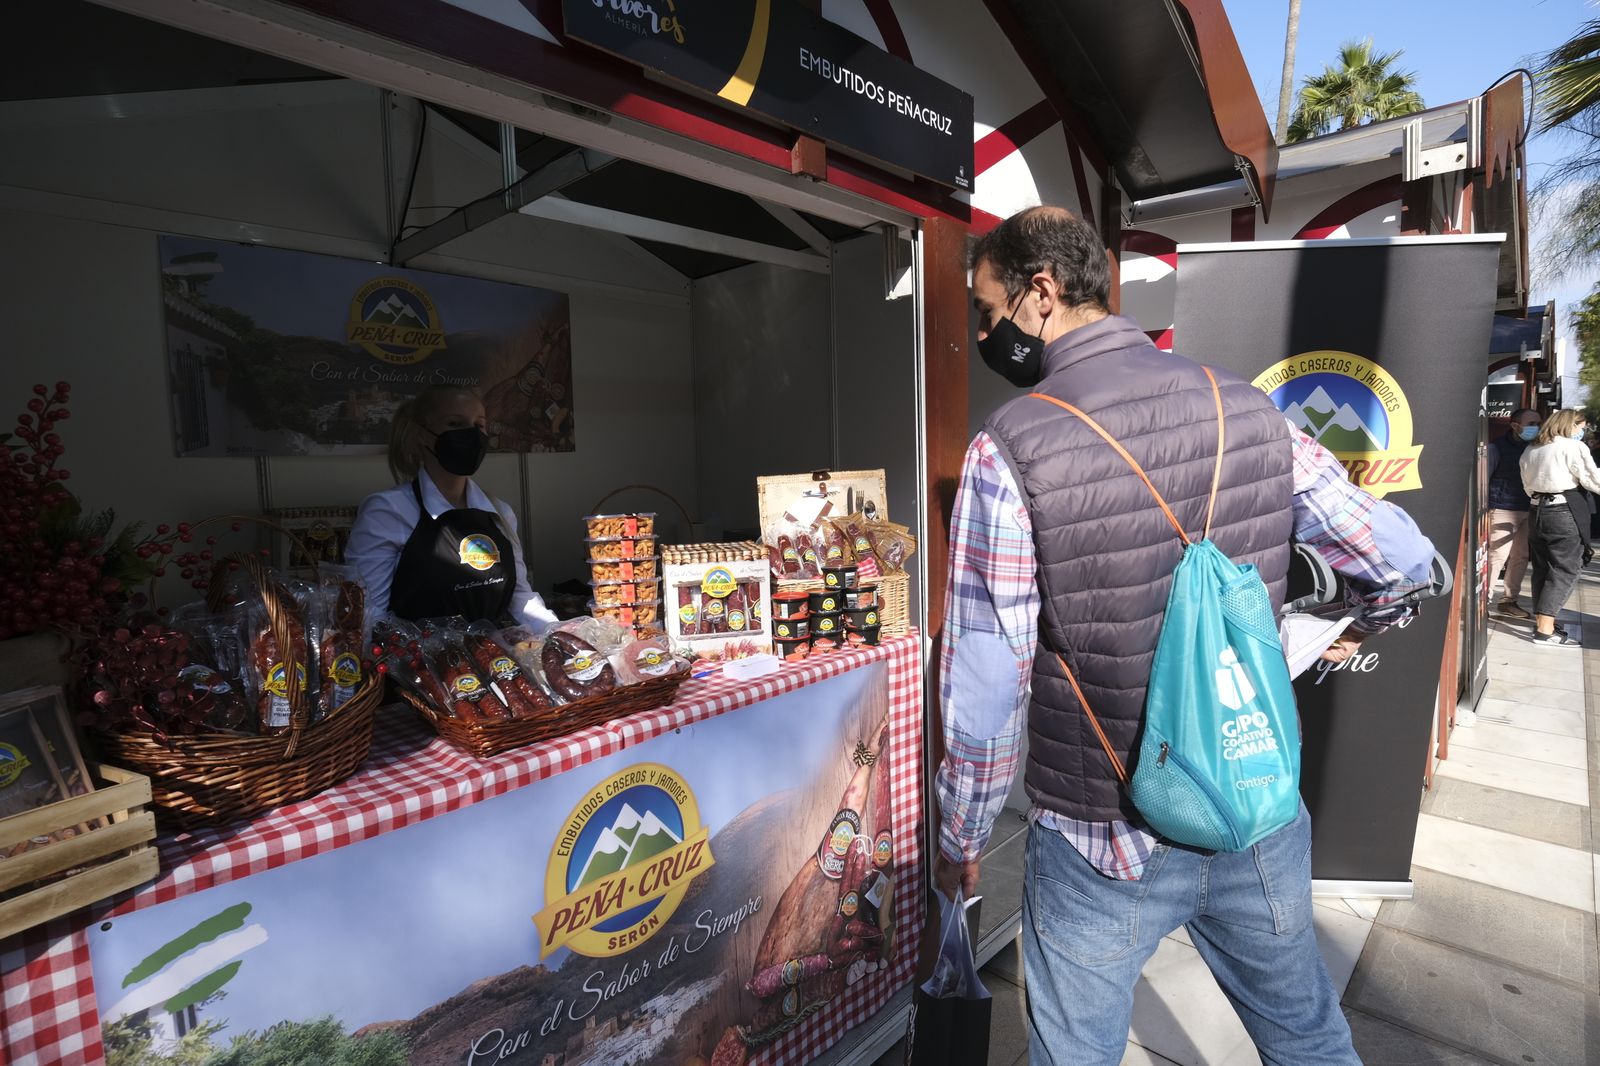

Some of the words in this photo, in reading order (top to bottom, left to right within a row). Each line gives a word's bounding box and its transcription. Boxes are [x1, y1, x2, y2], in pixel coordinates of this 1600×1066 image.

[800, 47, 885, 104] EMBUTIDOS
[888, 91, 953, 136] PEÑACRUZ
[1300, 357, 1351, 373] CASEROS
[1355, 364, 1363, 375] Y
[1361, 370, 1400, 412] JAMONES
[1340, 458, 1416, 488] RUZ
[557, 791, 604, 857] EMBUTIDOS
[605, 769, 647, 796] CASEROS
[650, 770, 656, 780] Y
[656, 772, 688, 806] JAMONES
[608, 914, 660, 950] SERÓN
[467, 1028, 532, 1066] Con
[540, 1000, 564, 1037] el
[568, 957, 651, 1021] Sabor
[657, 940, 680, 969] de
[684, 895, 762, 954] Siempre
